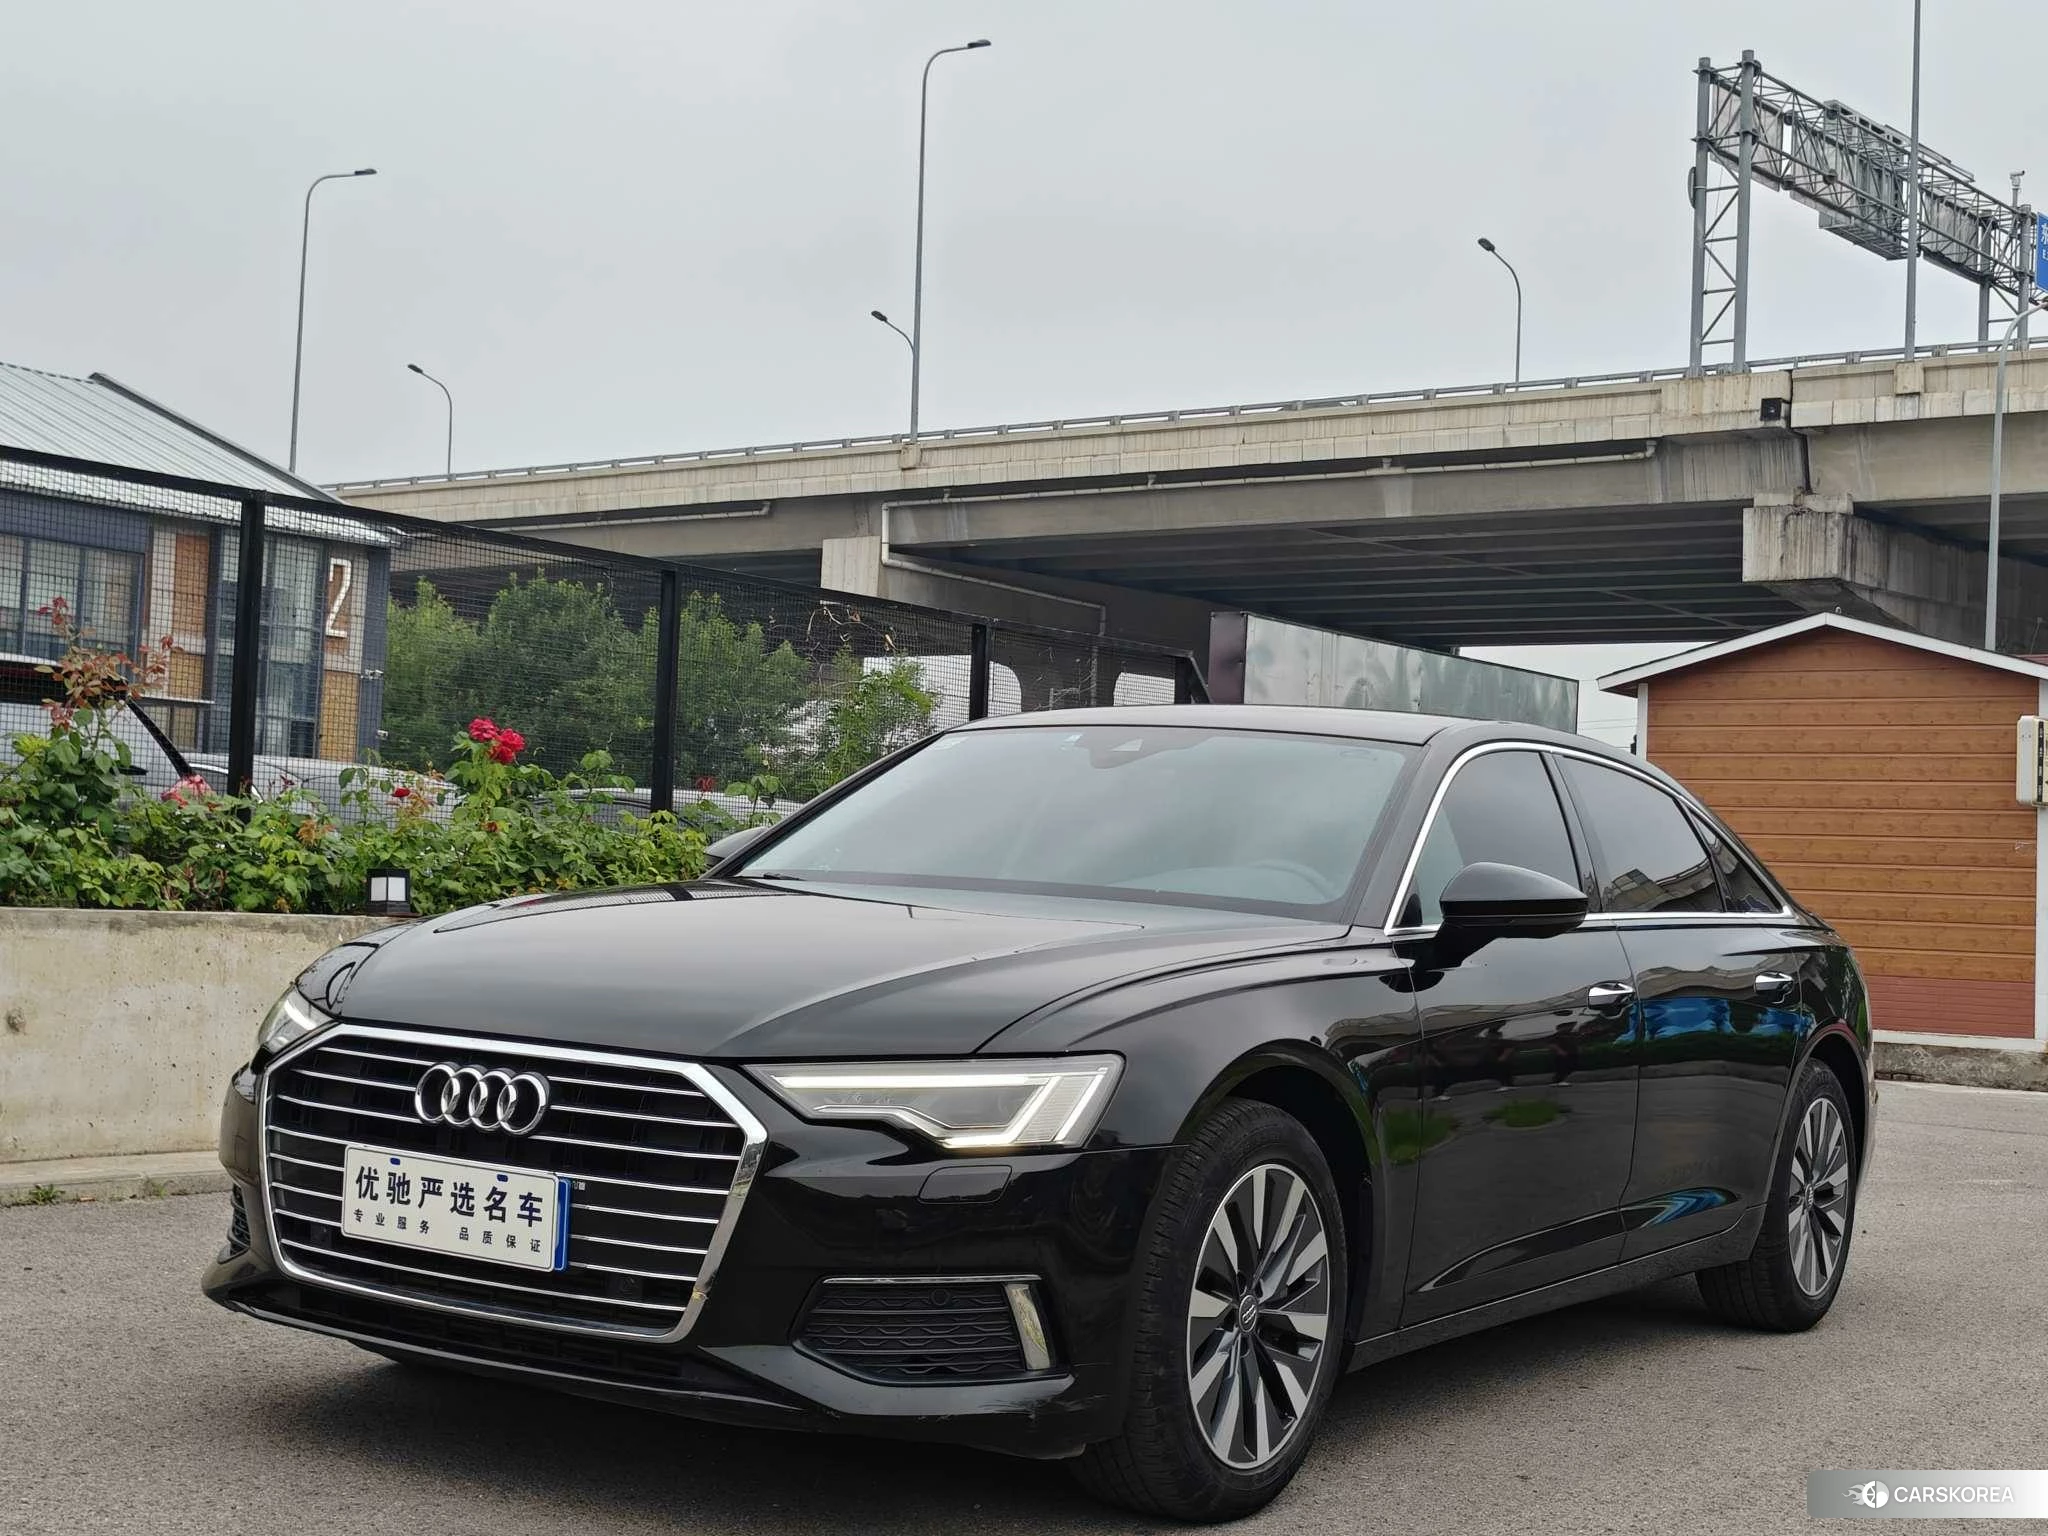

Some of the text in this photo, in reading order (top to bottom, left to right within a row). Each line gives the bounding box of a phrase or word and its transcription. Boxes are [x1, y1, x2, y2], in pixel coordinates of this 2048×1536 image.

[325, 557, 352, 638] 2
[355, 1165, 543, 1228] 优驰严选名车
[353, 1208, 541, 1254] 专业服务 品质保证
